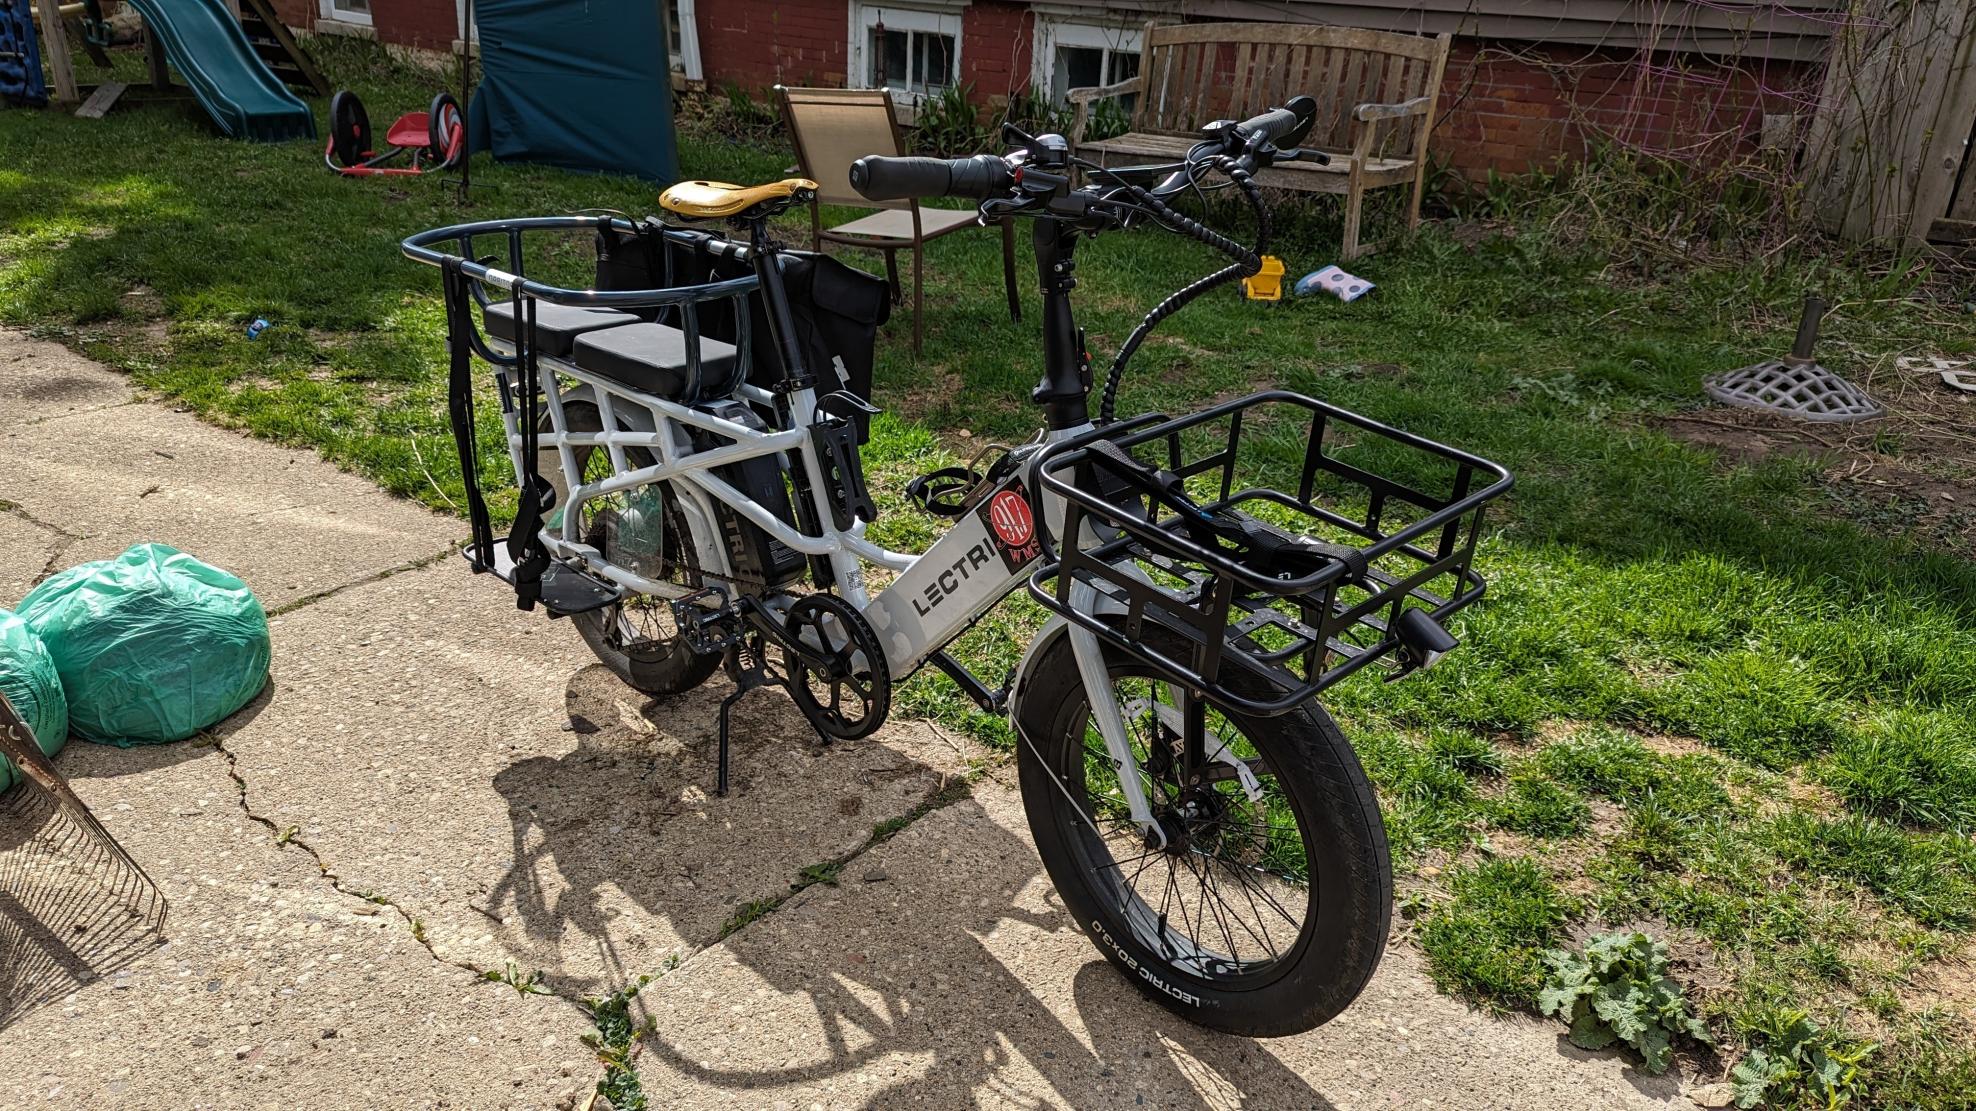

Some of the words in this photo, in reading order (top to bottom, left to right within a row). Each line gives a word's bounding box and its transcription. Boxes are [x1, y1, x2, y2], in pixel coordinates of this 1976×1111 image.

[911, 537, 997, 618] LECTRI
[1092, 920, 1138, 970] 20x3.0
[1138, 969, 1200, 1007] LECTRIC
